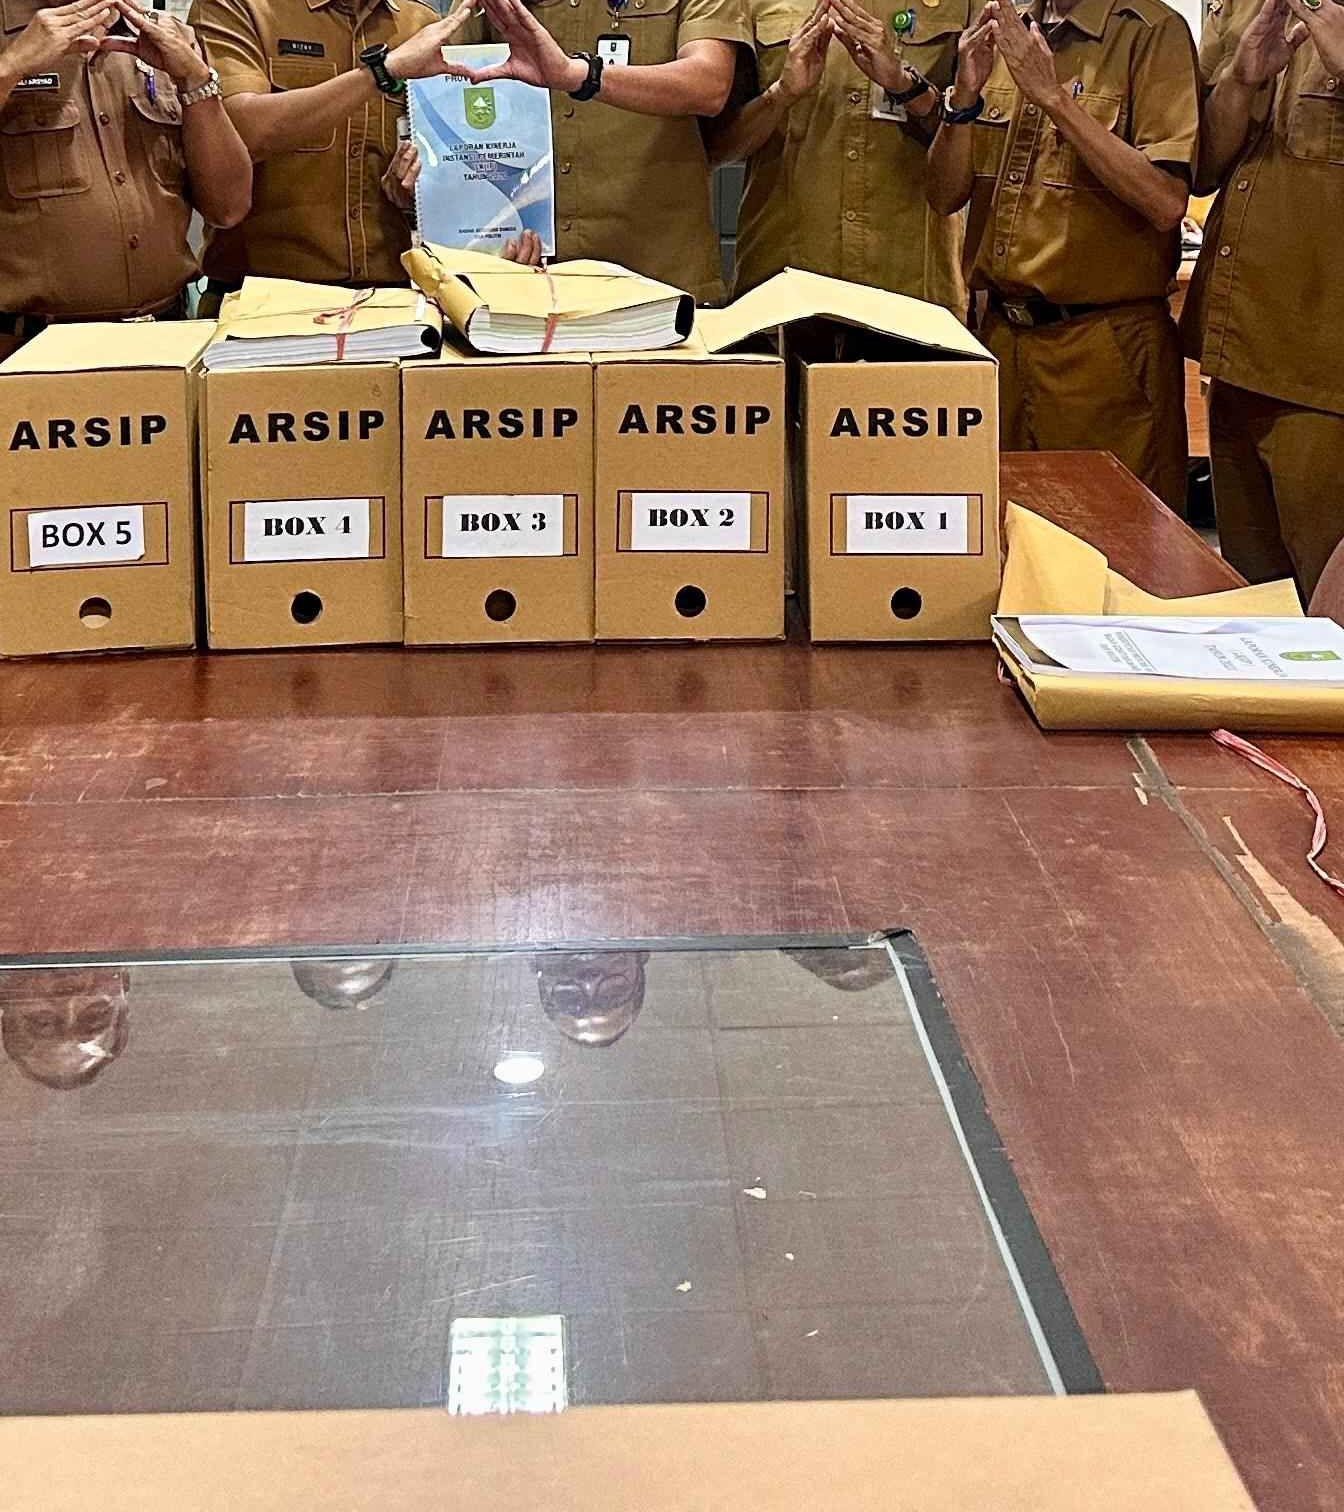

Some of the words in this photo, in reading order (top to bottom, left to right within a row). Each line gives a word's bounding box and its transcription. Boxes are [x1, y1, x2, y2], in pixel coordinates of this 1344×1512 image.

[8, 414, 167, 451] ARSIP
[228, 410, 385, 445] ARSIP
[424, 407, 578, 440] ARSIP
[618, 404, 771, 435] ARSIP
[830, 407, 983, 437] ARSIP
[263, 515, 328, 537] BOX
[335, 515, 351, 535] 4
[460, 512, 521, 532] BOX
[531, 512, 546, 531] 3
[648, 508, 711, 528] BOX
[719, 508, 735, 527] 2
[864, 511, 926, 530] BOX
[937, 511, 948, 530] 1
[42, 521, 105, 548] BOX
[115, 520, 132, 545] 5
